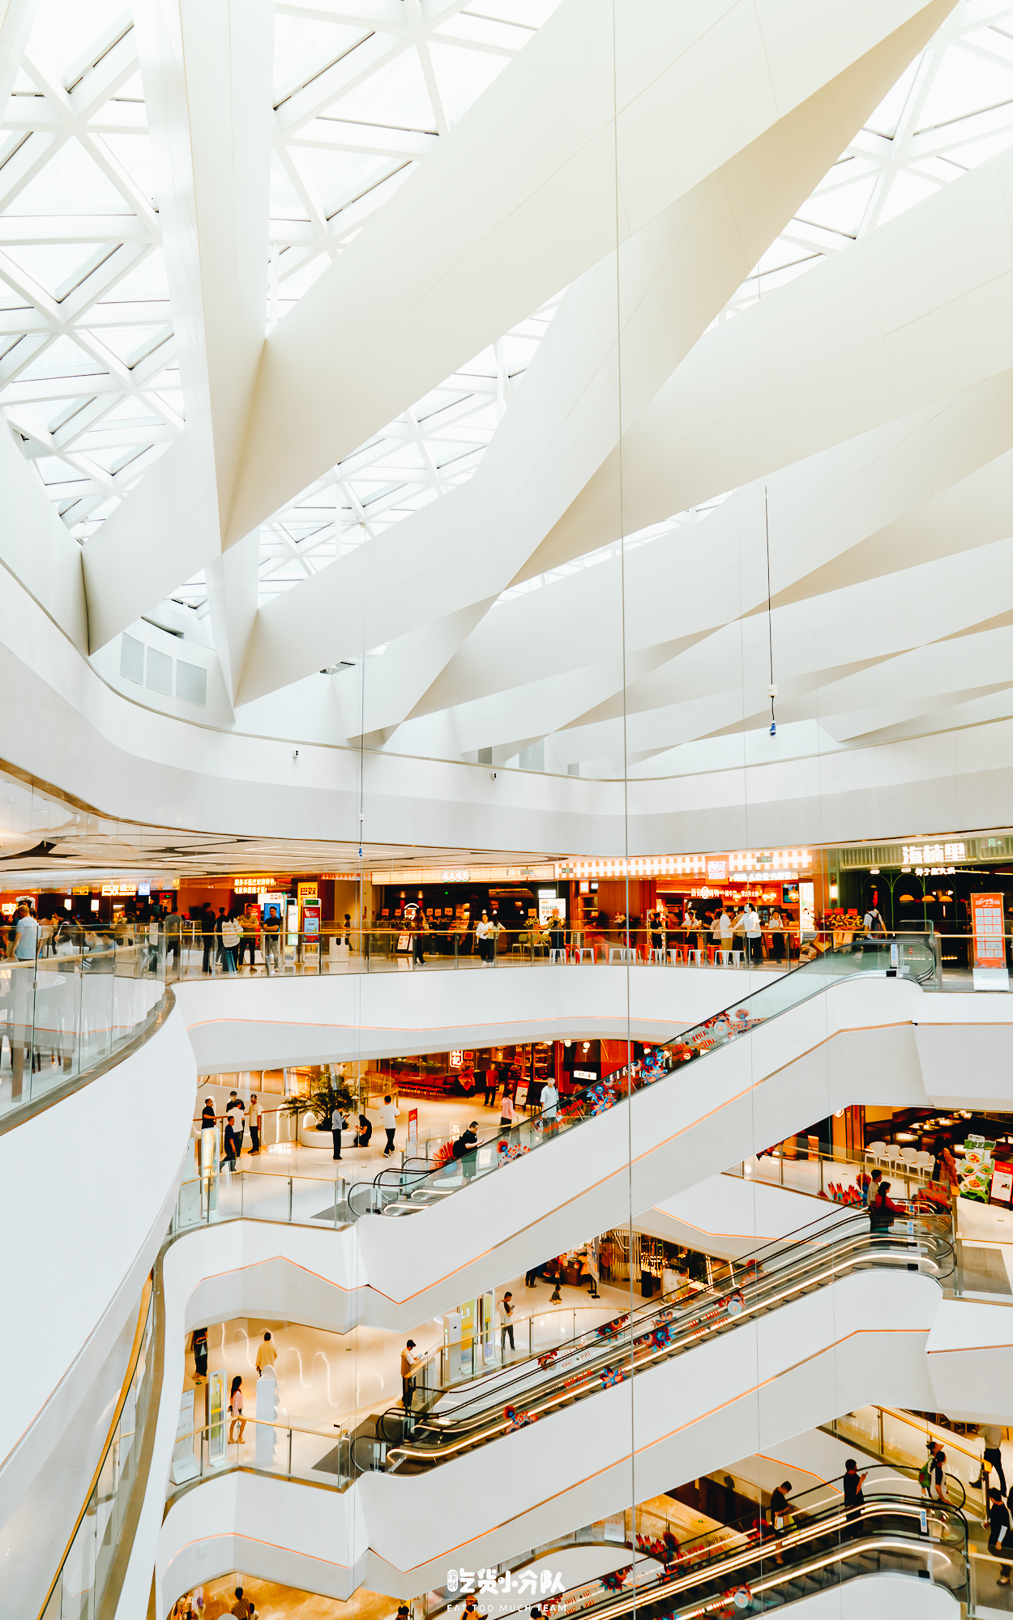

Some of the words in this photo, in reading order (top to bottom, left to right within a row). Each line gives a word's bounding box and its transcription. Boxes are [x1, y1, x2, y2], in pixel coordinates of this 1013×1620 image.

[708, 861, 726, 871] 西贝
[708, 872, 726, 880] XIBEI
[461, 1308, 470, 1319] L3
